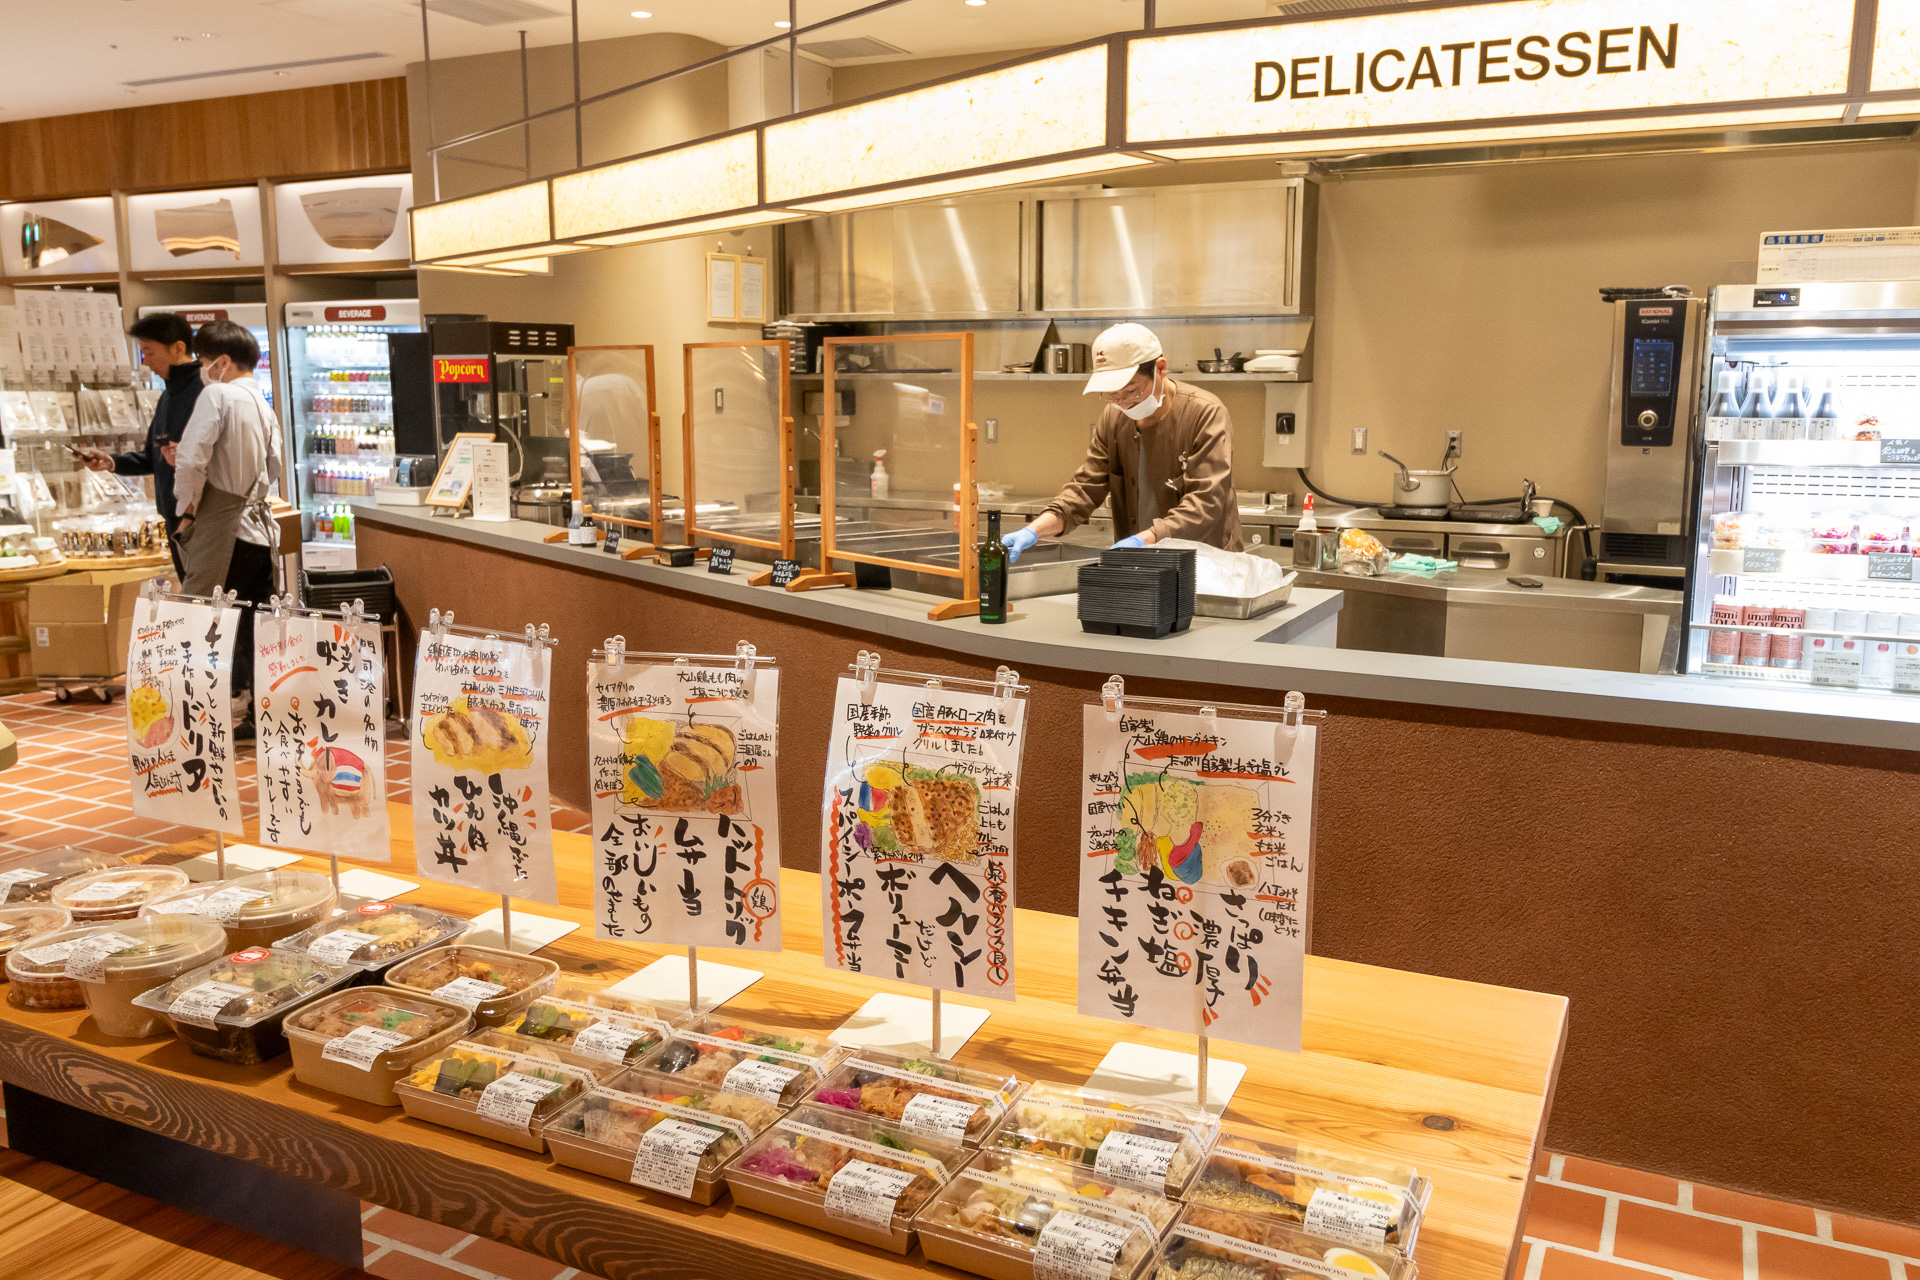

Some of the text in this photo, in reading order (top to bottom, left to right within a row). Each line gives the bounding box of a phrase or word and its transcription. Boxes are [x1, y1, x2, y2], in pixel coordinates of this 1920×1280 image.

[1254, 22, 1678, 103] DELICATESSEN
[186, 312, 216, 322] BEVERAGE
[338, 308, 372, 319] BEVERAGE
[439, 360, 485, 380] Popcorn
[358, 637, 379, 753] 門司港の名物
[314, 640, 357, 772] 焼きカレー
[846, 702, 892, 721] 国産季節
[911, 701, 1007, 726] 国産豚ロース肉を
[853, 722, 904, 740] 野菜のグリル
[1119, 714, 1155, 733] 自家製
[916, 723, 1018, 747] ガラムマサラで味付け
[259, 710, 281, 844] ヘルシーカレーです
[428, 784, 468, 873] カツ丼
[979, 816, 1007, 831] 上にも
[976, 831, 998, 843] カレー
[1254, 839, 1287, 856] もち米
[1265, 856, 1304, 873] ごはん
[600, 822, 629, 937] 全部のせました
[875, 862, 917, 979] ボリューミー
[929, 862, 983, 988] ヘルシー
[1137, 866, 1190, 979] ねぎ塩
[1096, 869, 1140, 1019] チキン弁当
[1219, 888, 1264, 991] さっぱり
[1189, 908, 1225, 1008] 濃厚
[955, 1111, 972, 1120] 799
[1153, 1155, 1171, 1165] 799
[1009, 1181, 1057, 1198] SHINANOYA
[1068, 1197, 1118, 1214] SHINANOYA
[1371, 1212, 1390, 1221] 799
[1101, 1239, 1121, 1251] 799
[1224, 1238, 1279, 1259] SHINANOYA
[1291, 1257, 1349, 1278] SHINANOYA
